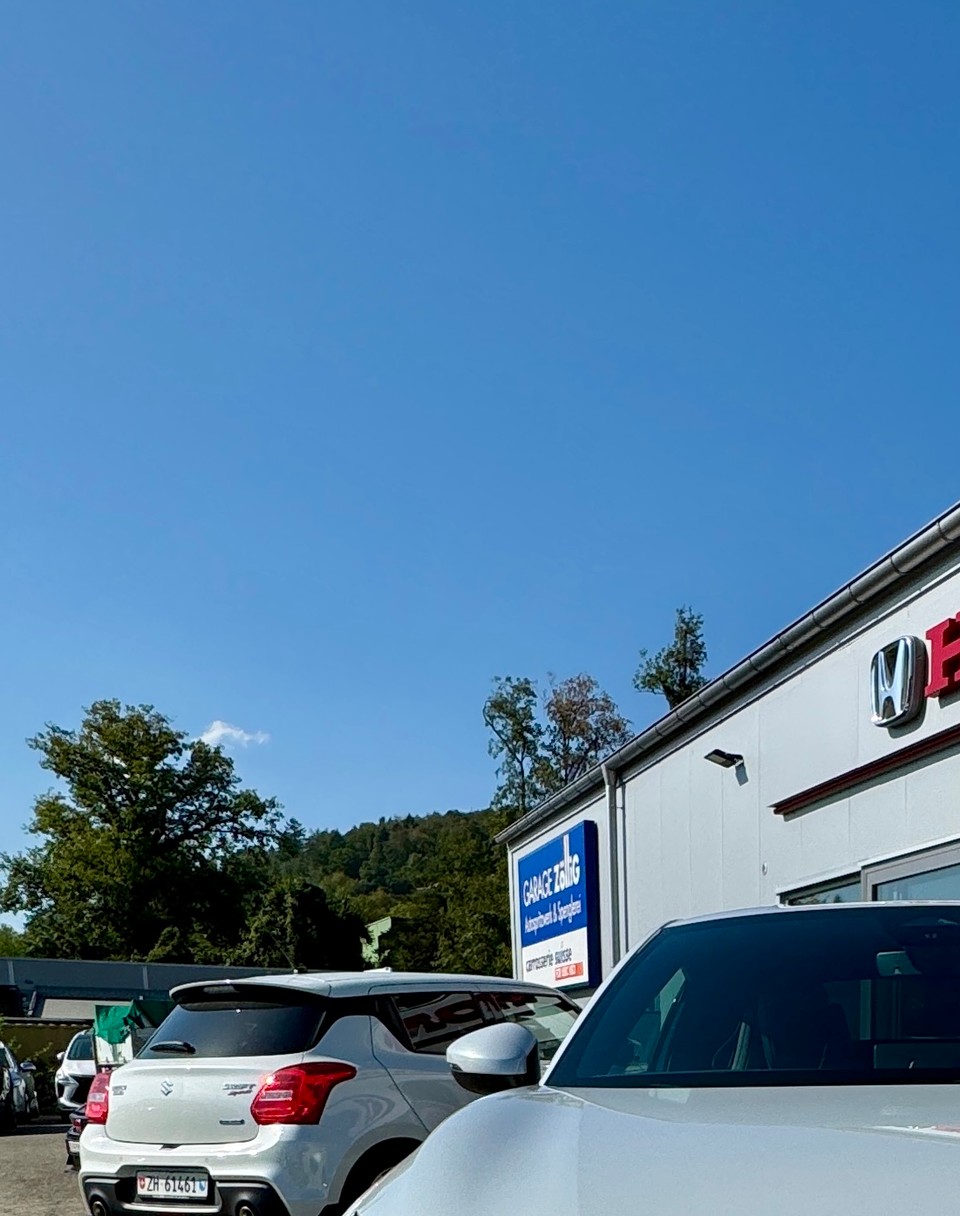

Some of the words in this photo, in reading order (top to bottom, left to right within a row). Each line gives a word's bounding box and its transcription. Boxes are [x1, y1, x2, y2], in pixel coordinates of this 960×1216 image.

[523, 867, 553, 906] GARAGE
[146, 1175, 160, 1192] ZH
[164, 1174, 197, 1194] 61461
